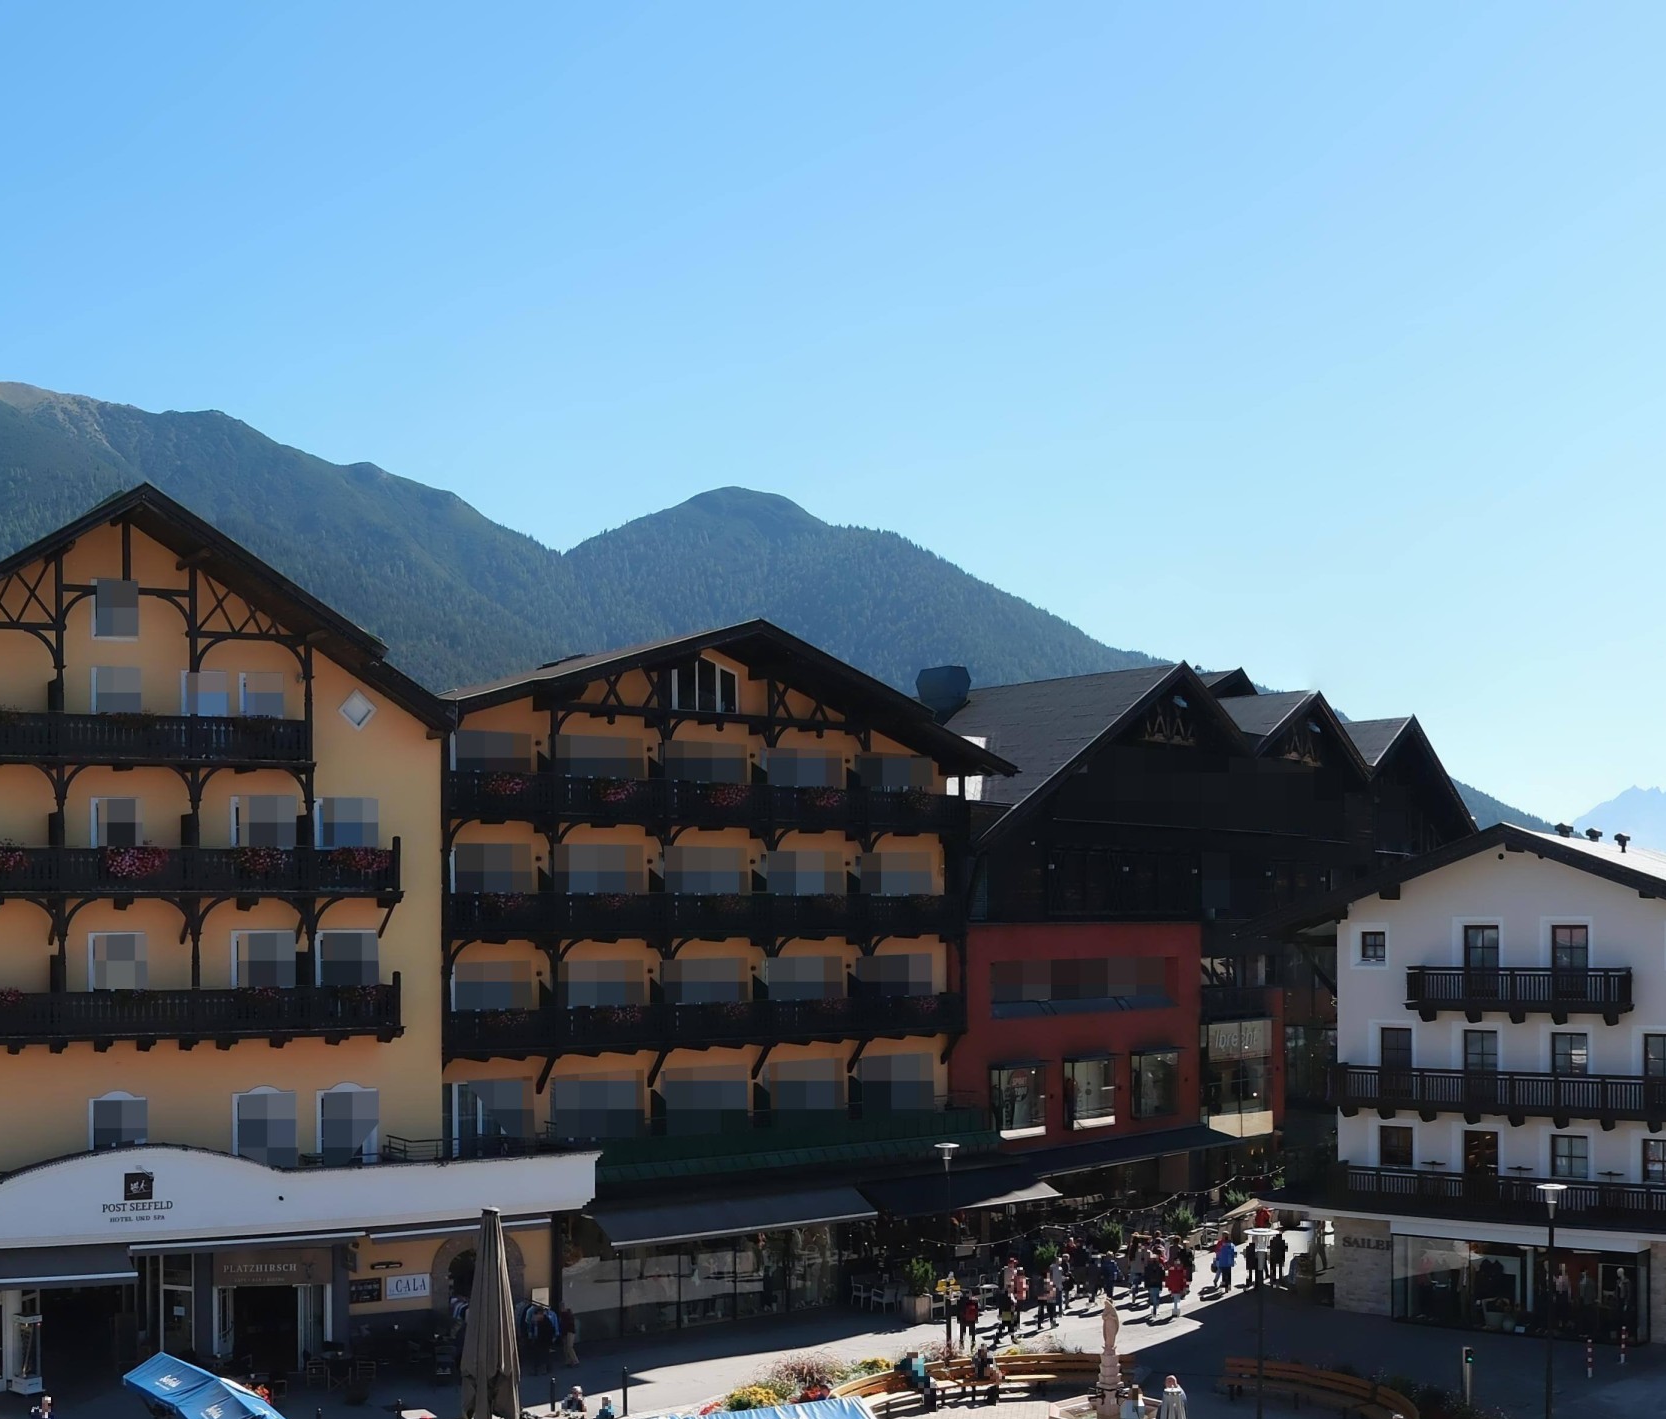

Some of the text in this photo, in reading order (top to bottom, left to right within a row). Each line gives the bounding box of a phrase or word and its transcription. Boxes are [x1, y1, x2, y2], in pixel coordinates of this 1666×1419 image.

[102, 1200, 174, 1213] POST SEEFELD
[223, 1263, 297, 1273] PLATZHIRSCH
